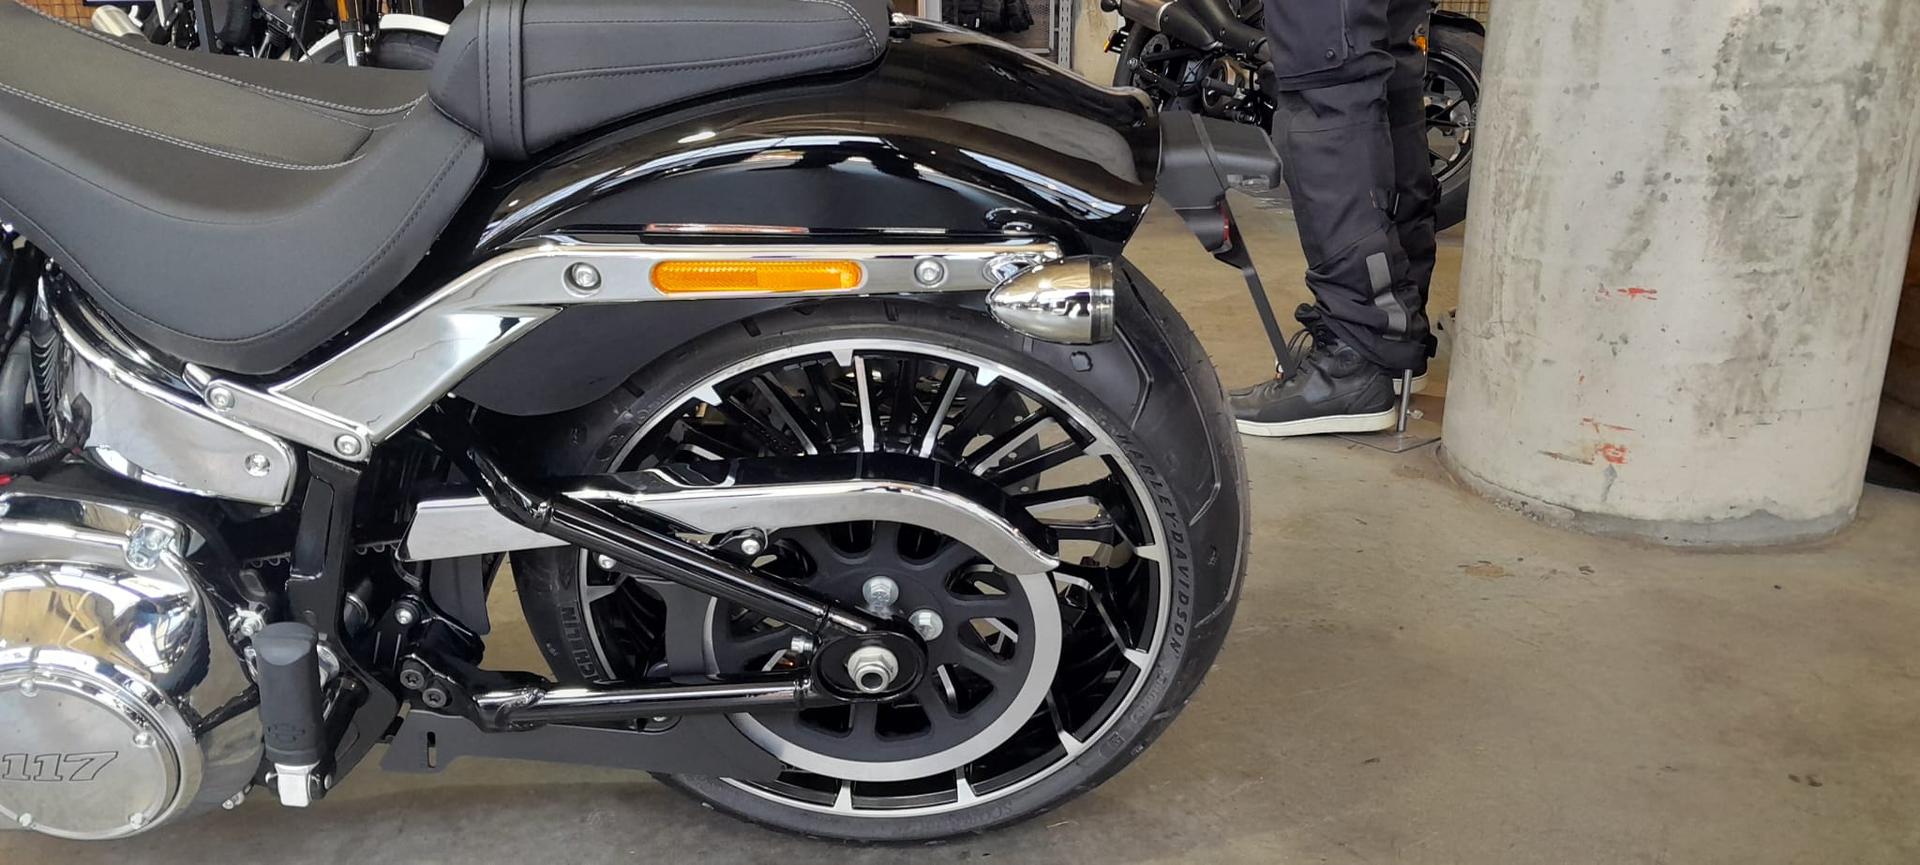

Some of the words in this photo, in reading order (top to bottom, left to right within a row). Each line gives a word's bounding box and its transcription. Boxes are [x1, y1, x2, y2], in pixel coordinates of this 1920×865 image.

[1115, 433, 1191, 657] HARLEY-DAVIDSON
[560, 604, 600, 681] ICHELIN
[1, 750, 119, 782] 117
